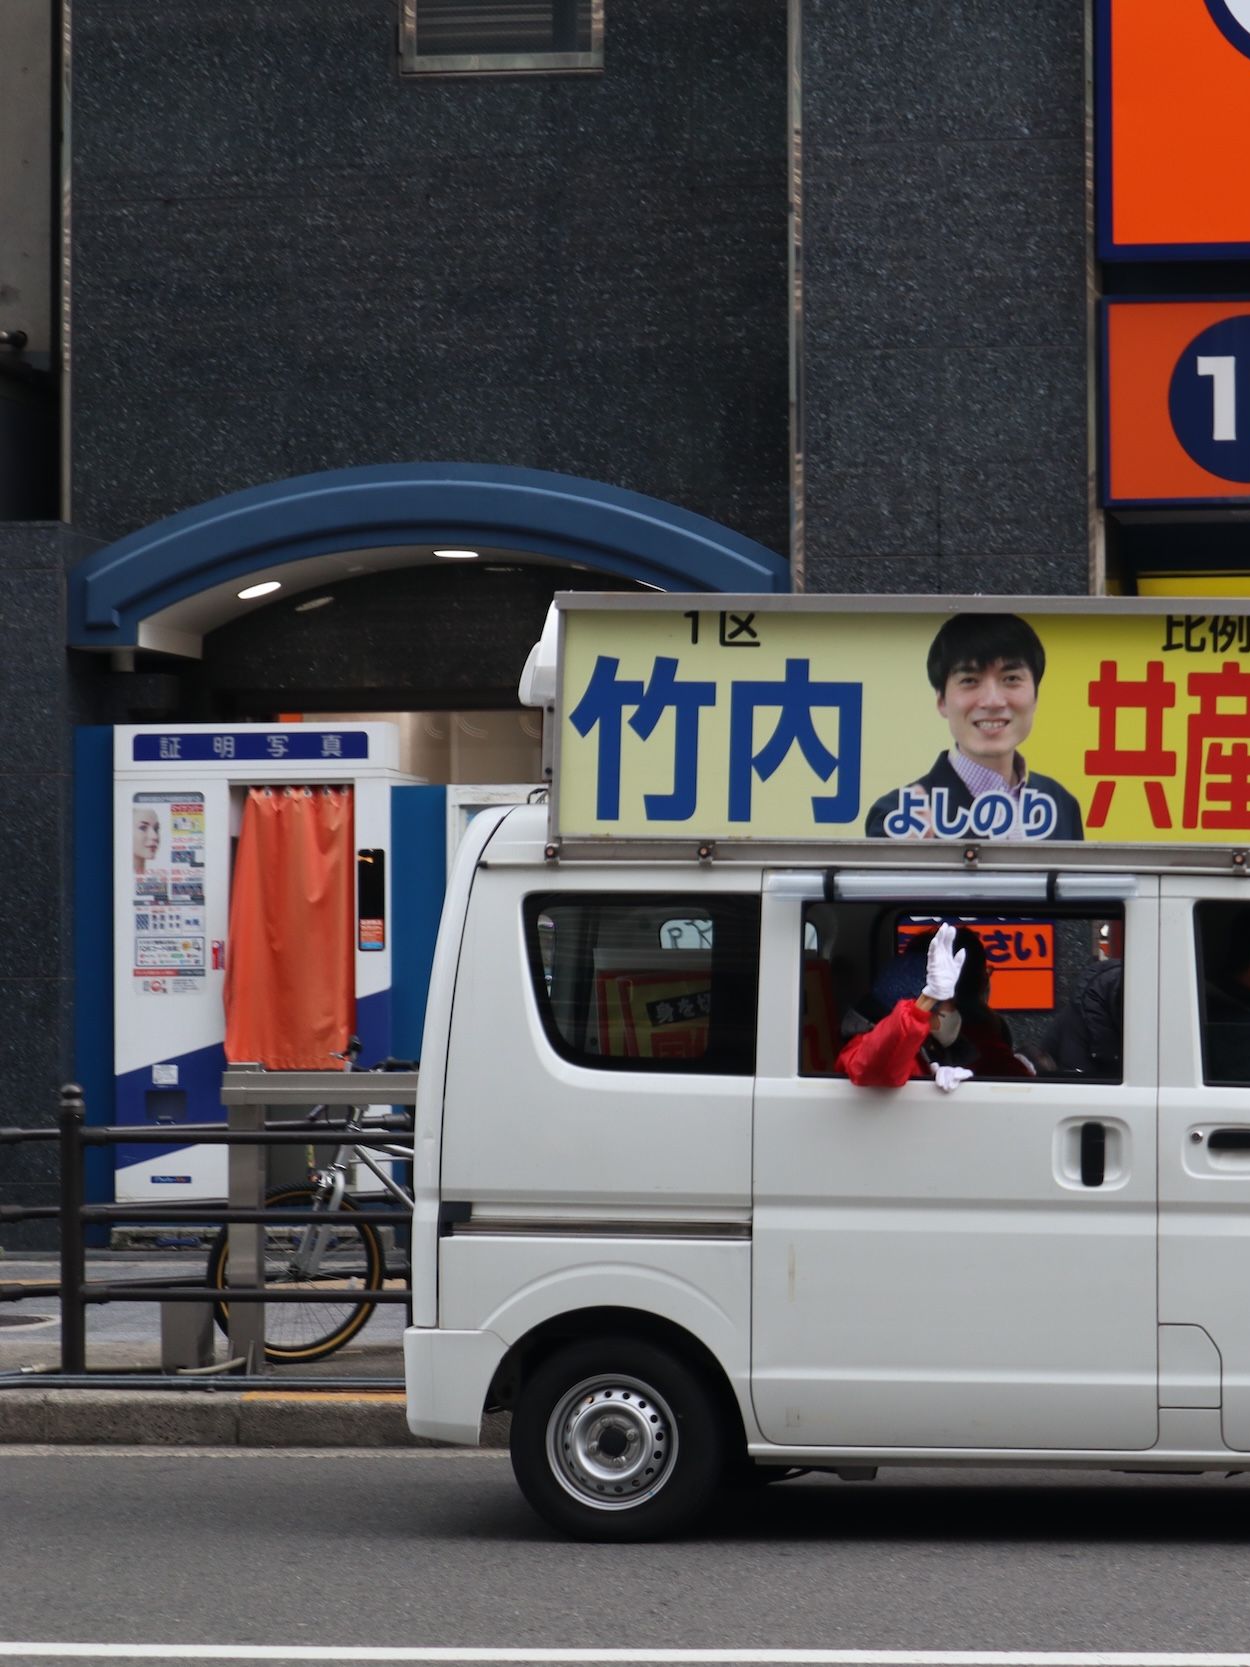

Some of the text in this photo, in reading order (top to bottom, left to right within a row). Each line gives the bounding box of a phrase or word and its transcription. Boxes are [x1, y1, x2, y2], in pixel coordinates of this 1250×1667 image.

[159, 735, 343, 758] 証明写真
[569, 655, 863, 824] 竹内
[884, 787, 1058, 840] よしのり
